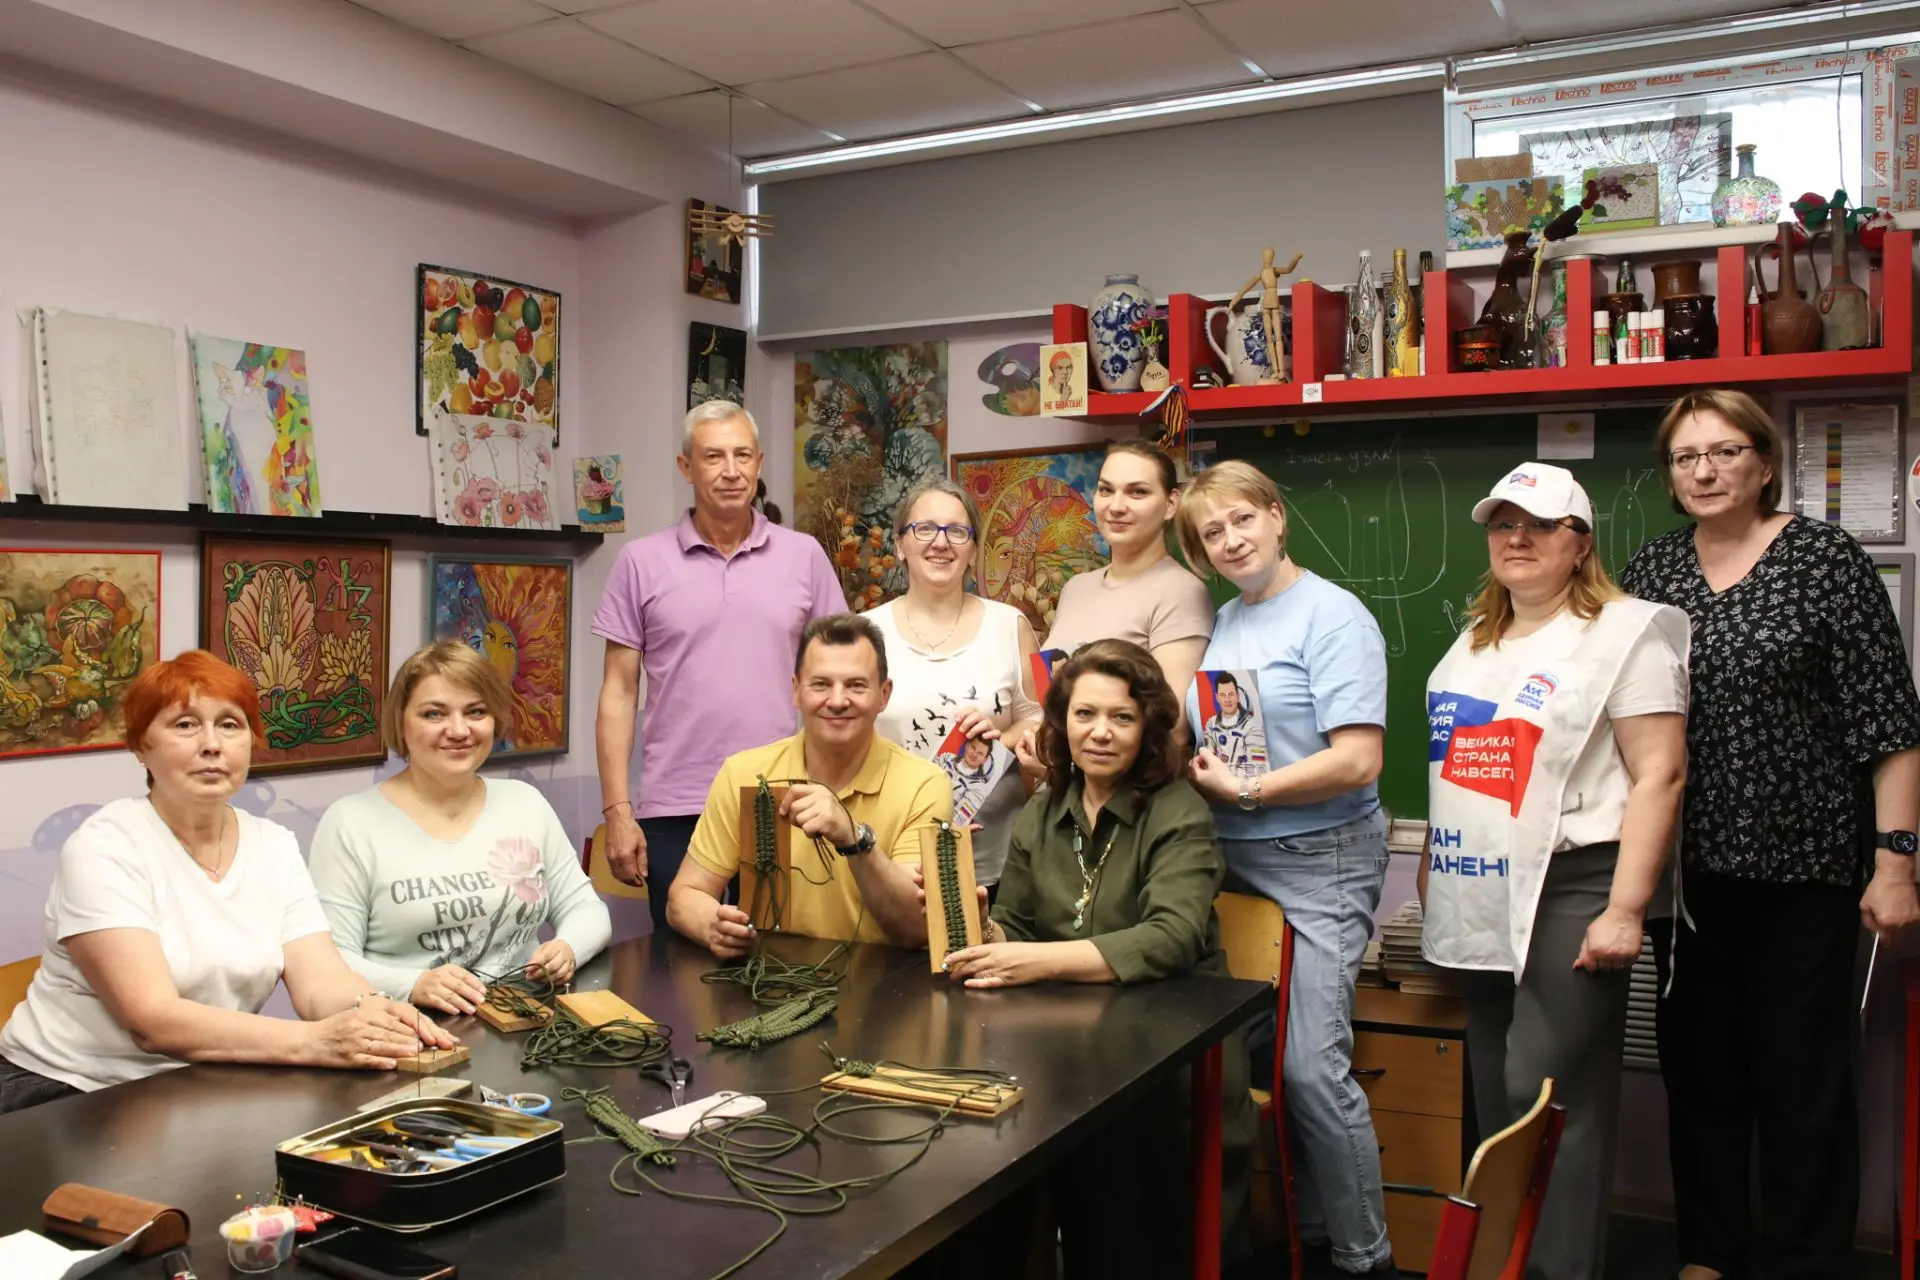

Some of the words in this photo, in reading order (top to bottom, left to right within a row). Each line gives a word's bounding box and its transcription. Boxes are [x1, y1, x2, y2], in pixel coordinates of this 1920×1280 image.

[1453, 751, 1511, 764] СТРАНА
[1430, 827, 1461, 849] АН
[1428, 852, 1509, 877] АНЕН
[390, 870, 496, 905] CHANGE
[432, 894, 488, 926] FOR
[417, 923, 474, 952] CITY
